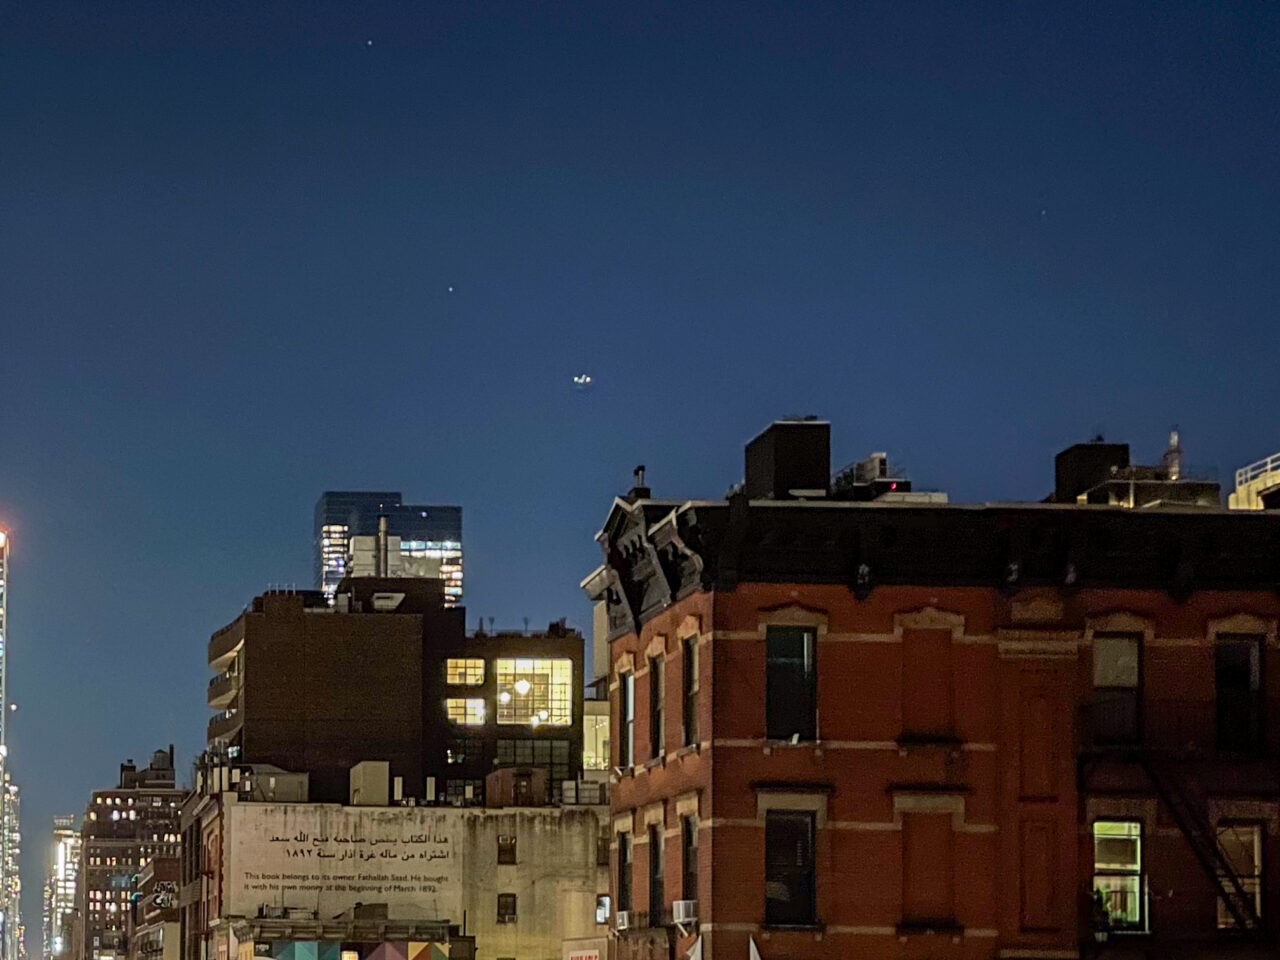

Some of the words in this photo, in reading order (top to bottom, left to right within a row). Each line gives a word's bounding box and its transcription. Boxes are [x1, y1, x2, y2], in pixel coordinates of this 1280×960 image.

[401, 850, 415, 861] من
[244, 872, 259, 880] This
[261, 872, 280, 880] book
[282, 872, 309, 882] belongs
[322, 873, 330, 881] its
[357, 872, 389, 881] Fathallah
[410, 873, 421, 882] He
[423, 873, 448, 884] bought
[299, 884, 323, 893] money
[334, 884, 347, 892] the
[348, 884, 382, 893] beginning
[384, 884, 392, 892] of
[393, 885, 417, 893] March
